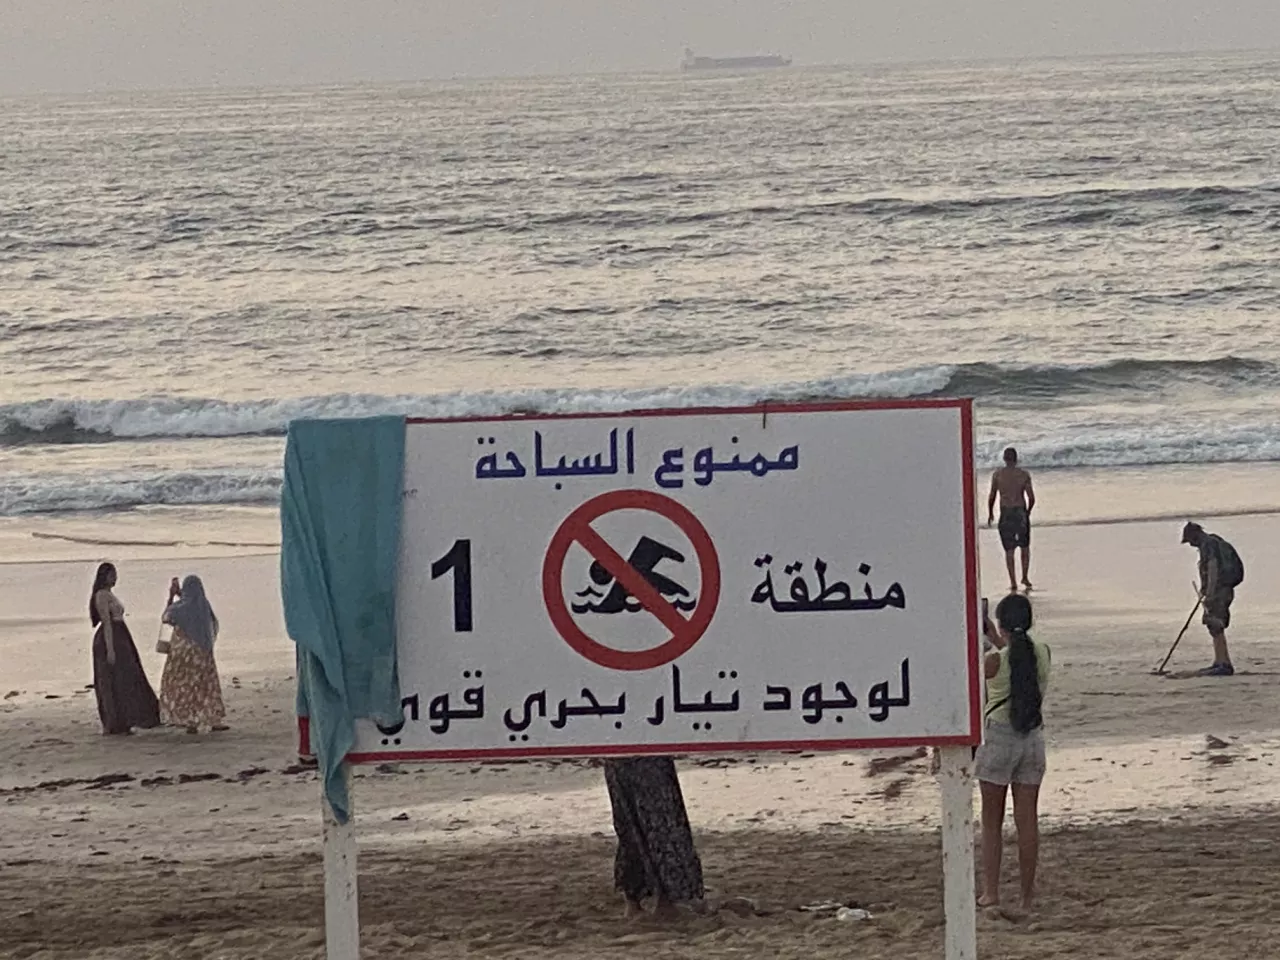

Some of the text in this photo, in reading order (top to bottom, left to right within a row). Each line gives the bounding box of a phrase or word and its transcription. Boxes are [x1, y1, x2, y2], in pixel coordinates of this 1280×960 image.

[475, 427, 799, 491] ممنوع السباحة
[430, 538, 906, 633] منطقة 1
[376, 657, 910, 746] لوجود تيار بحري قوي
